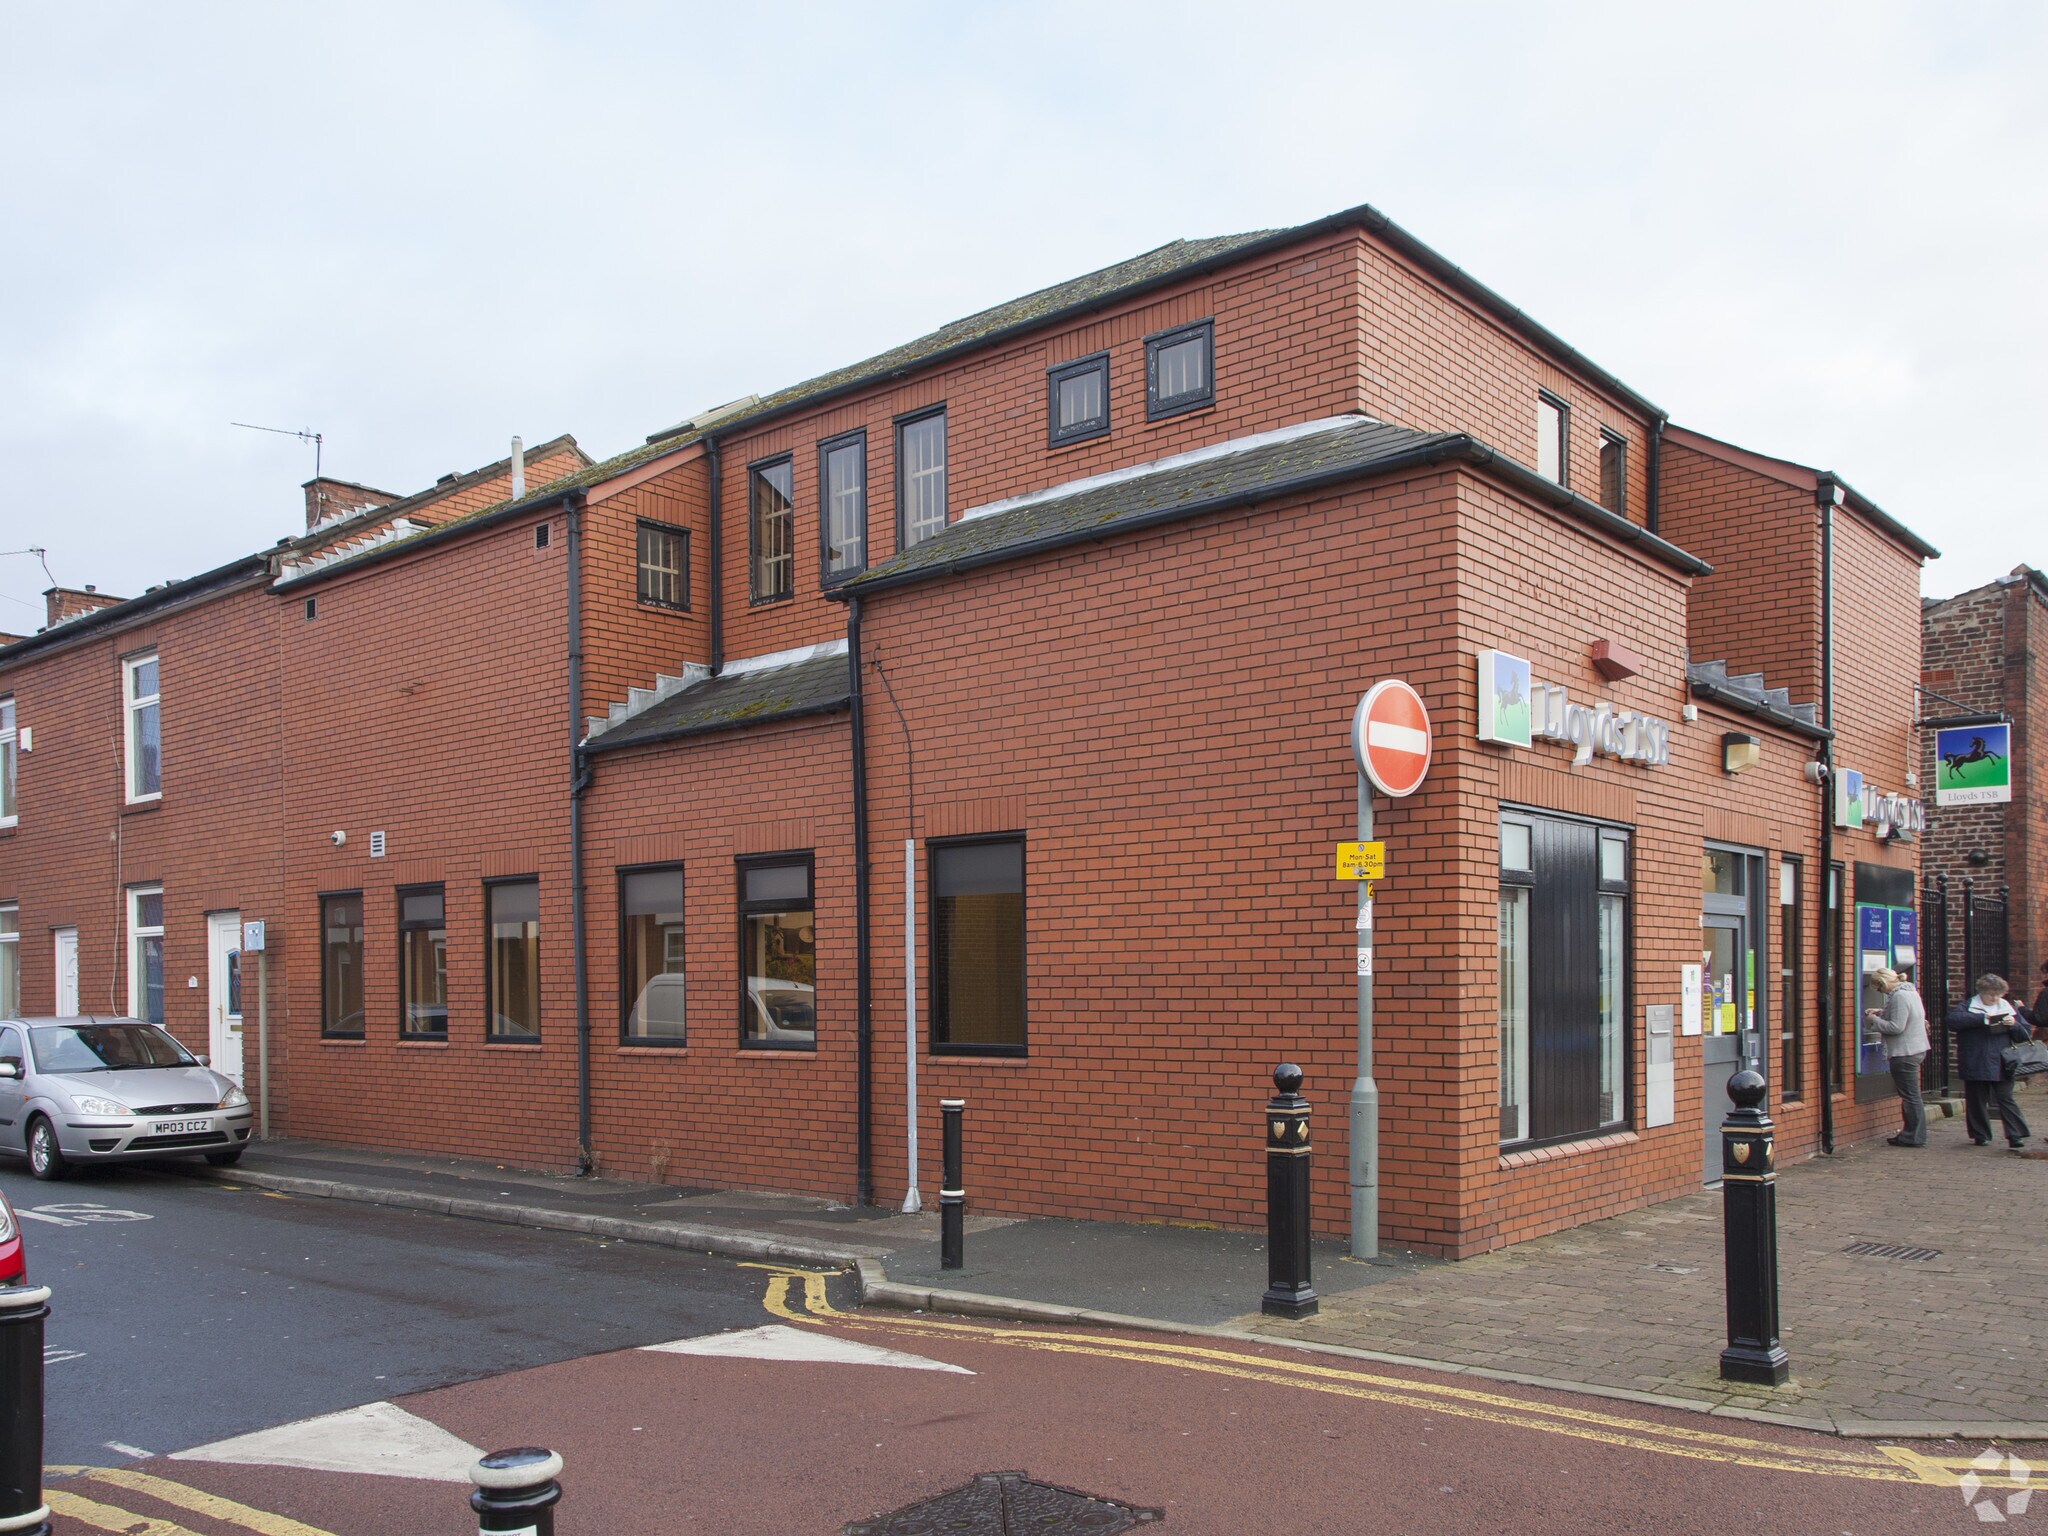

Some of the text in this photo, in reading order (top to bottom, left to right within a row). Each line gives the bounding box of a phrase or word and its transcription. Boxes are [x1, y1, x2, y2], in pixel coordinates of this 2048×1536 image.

[1537, 682, 1669, 765] Lloyds TSB
[1865, 785, 1904, 837] Lloyds
[1948, 791, 1998, 802] Lloyds TSB
[156, 1121, 207, 1133] MP03 CCZ
